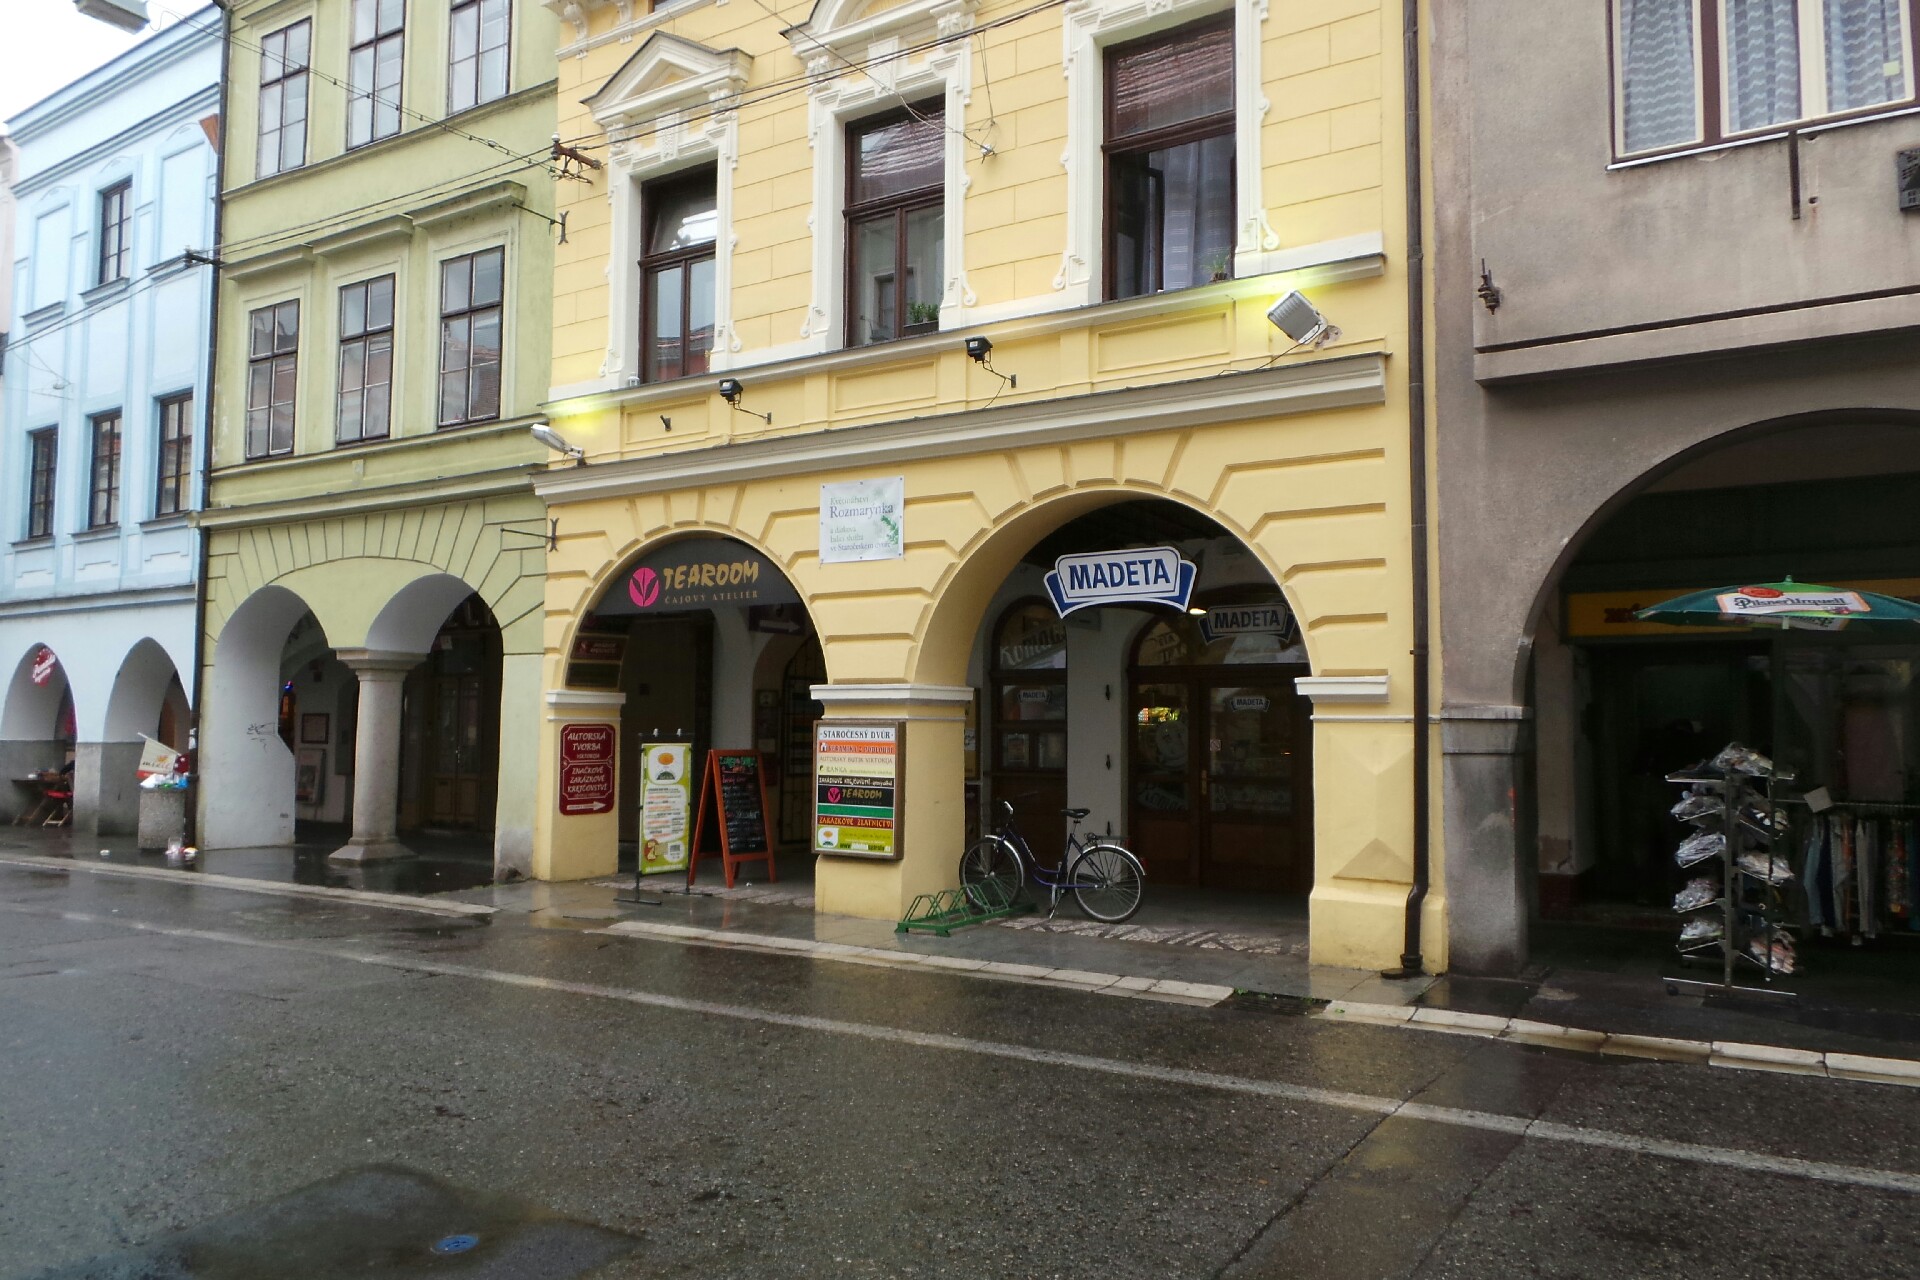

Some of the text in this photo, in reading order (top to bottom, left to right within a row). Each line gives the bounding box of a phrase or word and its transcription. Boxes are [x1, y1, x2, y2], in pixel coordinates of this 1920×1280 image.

[829, 502, 894, 520] Rozmarýnka
[663, 560, 759, 590] TEAROOM
[1069, 558, 1171, 591] MADETA
[1734, 597, 1845, 609] Pilsner Urquell
[1214, 608, 1281, 630] MADETA
[1022, 691, 1046, 699] MADETA
[1236, 698, 1264, 706] MADETA
[823, 729, 869, 739] STAROČESKÝ
[572, 742, 601, 751] TVORBA
[572, 766, 604, 775] ZNAČKOVÉ
[842, 788, 882, 799] TEAROOM
